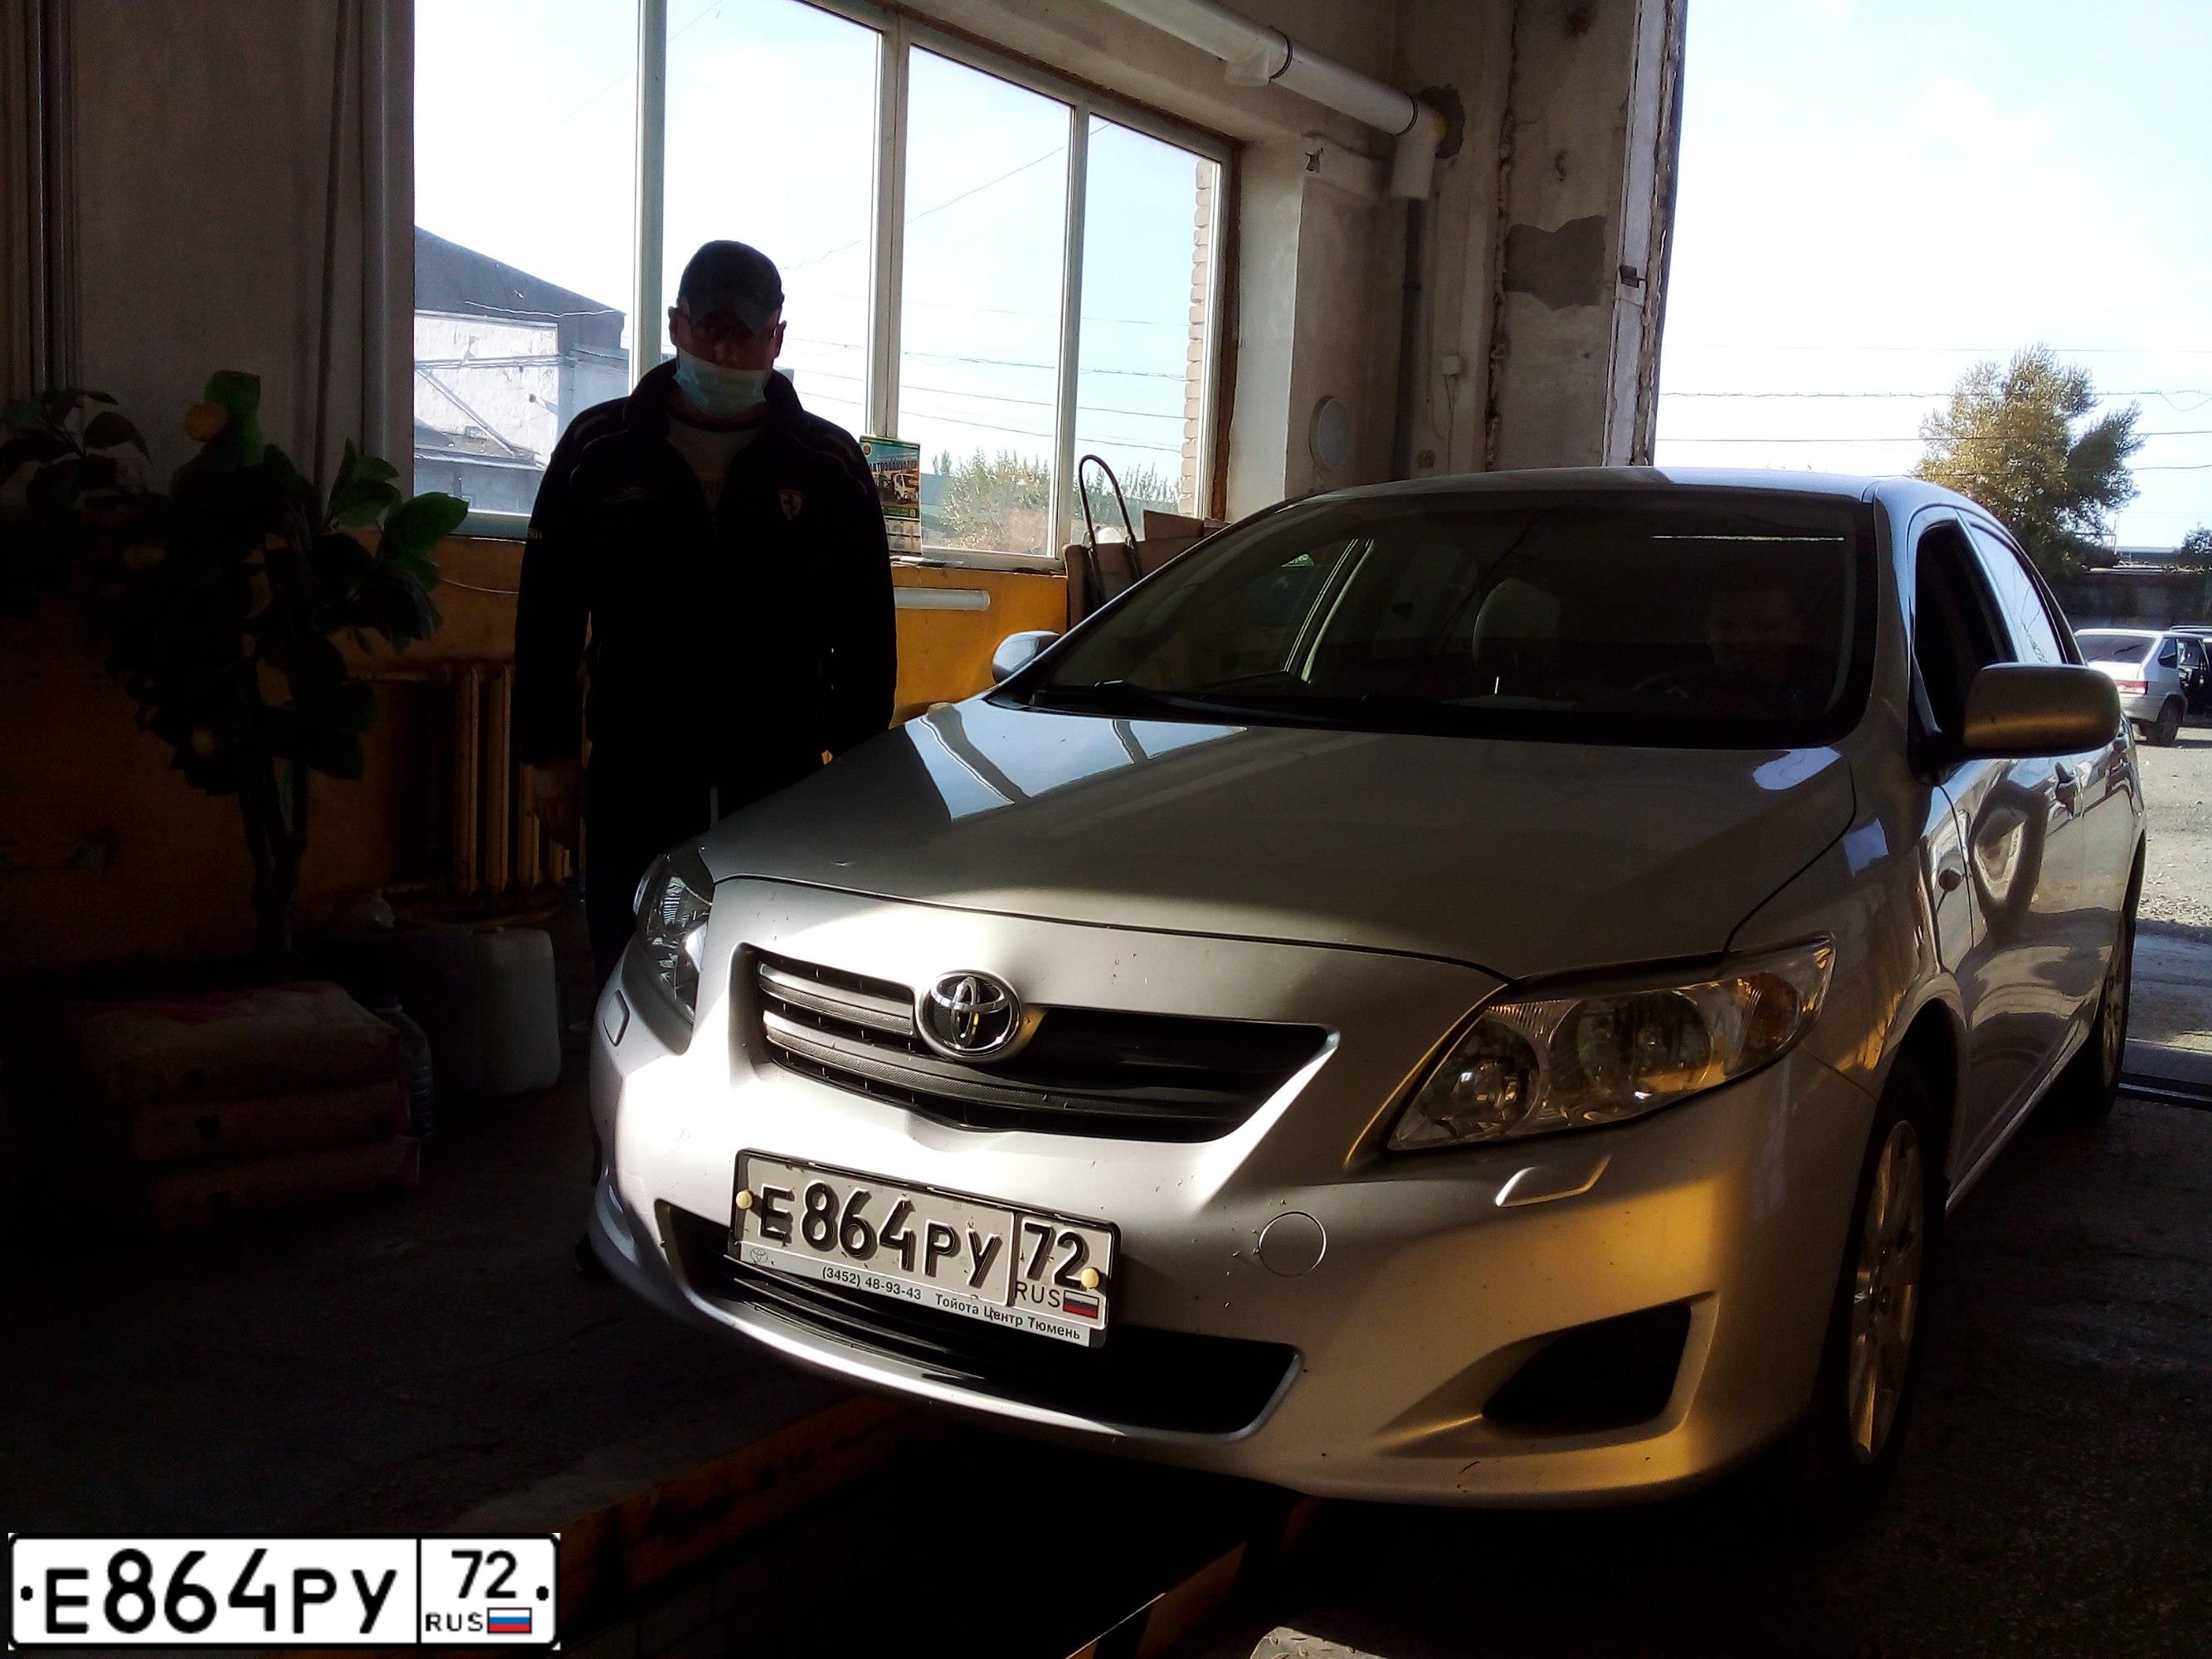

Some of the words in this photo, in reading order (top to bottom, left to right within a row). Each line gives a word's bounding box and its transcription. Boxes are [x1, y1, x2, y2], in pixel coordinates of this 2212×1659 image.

[1023, 1221, 1089, 1290] 72
[822, 1266, 861, 1287] (3452)
[865, 1277, 922, 1300] 48-93-43
[935, 1292, 979, 1316] Тойота
[984, 1306, 1023, 1327] Центр
[1027, 1316, 1080, 1340] Тюмень
[1015, 1281, 1061, 1308] RUS
